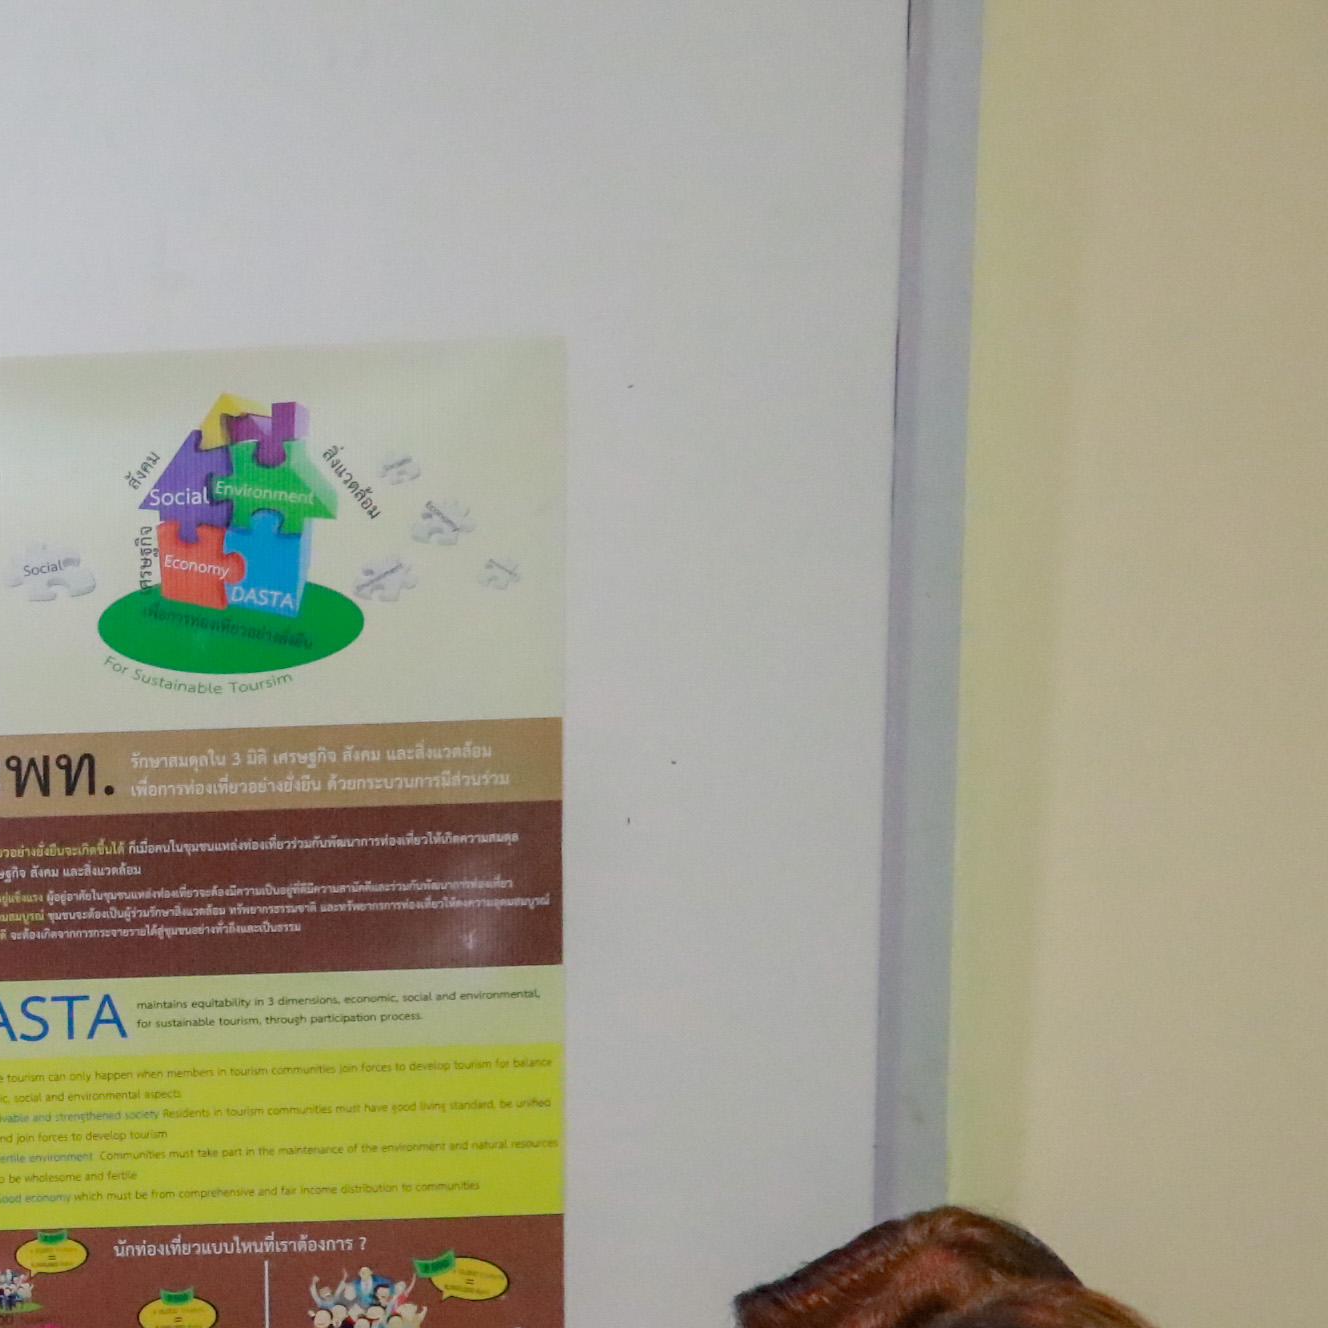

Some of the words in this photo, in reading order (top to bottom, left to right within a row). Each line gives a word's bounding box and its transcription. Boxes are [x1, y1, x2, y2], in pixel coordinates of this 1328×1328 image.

[126, 451, 161, 490] สังคม
[322, 444, 382, 520] สิ่งแวดล้อม
[149, 486, 210, 506] Social
[215, 480, 315, 505] Environment
[425, 500, 461, 533] Economy
[23, 559, 64, 577] Social
[164, 553, 231, 579] Economy
[230, 586, 295, 609] DASTA
[102, 655, 129, 673] For
[132, 668, 224, 694] Sustainable
[130, 749, 226, 771] รักษาสมดุลใน
[231, 754, 242, 766] 3
[273, 746, 337, 769] เศรษฐกิจ
[343, 744, 381, 763] สังคม
[386, 738, 493, 762] และสิ่งแวดล้อม
[30, 864, 59, 879] สังคม
[62, 859, 142, 878] และสิ่งแวดล้อม
[137, 1000, 187, 1011] maintains
[191, 998, 251, 1010] equitability
[254, 998, 264, 1007] in
[268, 997, 274, 1006] 3
[278, 995, 341, 1006] dimensions,
[344, 994, 399, 1005] economic,
[403, 992, 432, 1002] social
[436, 990, 456, 1001] and
[460, 989, 541, 1001] environmental,
[137, 1018, 152, 1029] for
[155, 1016, 215, 1028] sustainable
[219, 1016, 262, 1026] tourism,
[265, 1014, 306, 1027] through
[310, 1011, 376, 1025] participation
[380, 1012, 422, 1023] process.
[7, 1073, 44, 1083] tourism
[48, 1073, 66, 1082] can
[69, 1071, 92, 1083] only
[95, 1070, 134, 1083] happen
[137, 1069, 164, 1079] when
[167, 1067, 213, 1079] members
[217, 1067, 227, 1076] in
[230, 1066, 269, 1077] tourism
[271, 1064, 336, 1076] communities
[339, 1063, 358, 1075] join
[361, 1062, 392, 1072] forces
[395, 1062, 406, 1072] to
[409, 1060, 451, 1073] develop
[454, 1059, 492, 1070] tourism
[495, 1059, 510, 1069] for
[513, 1057, 553, 1068] balance
[113, 1235, 354, 1258] นักท่องเที่ยวแบบไหนที่เราต้องการ
[360, 1236, 367, 1251] ?
